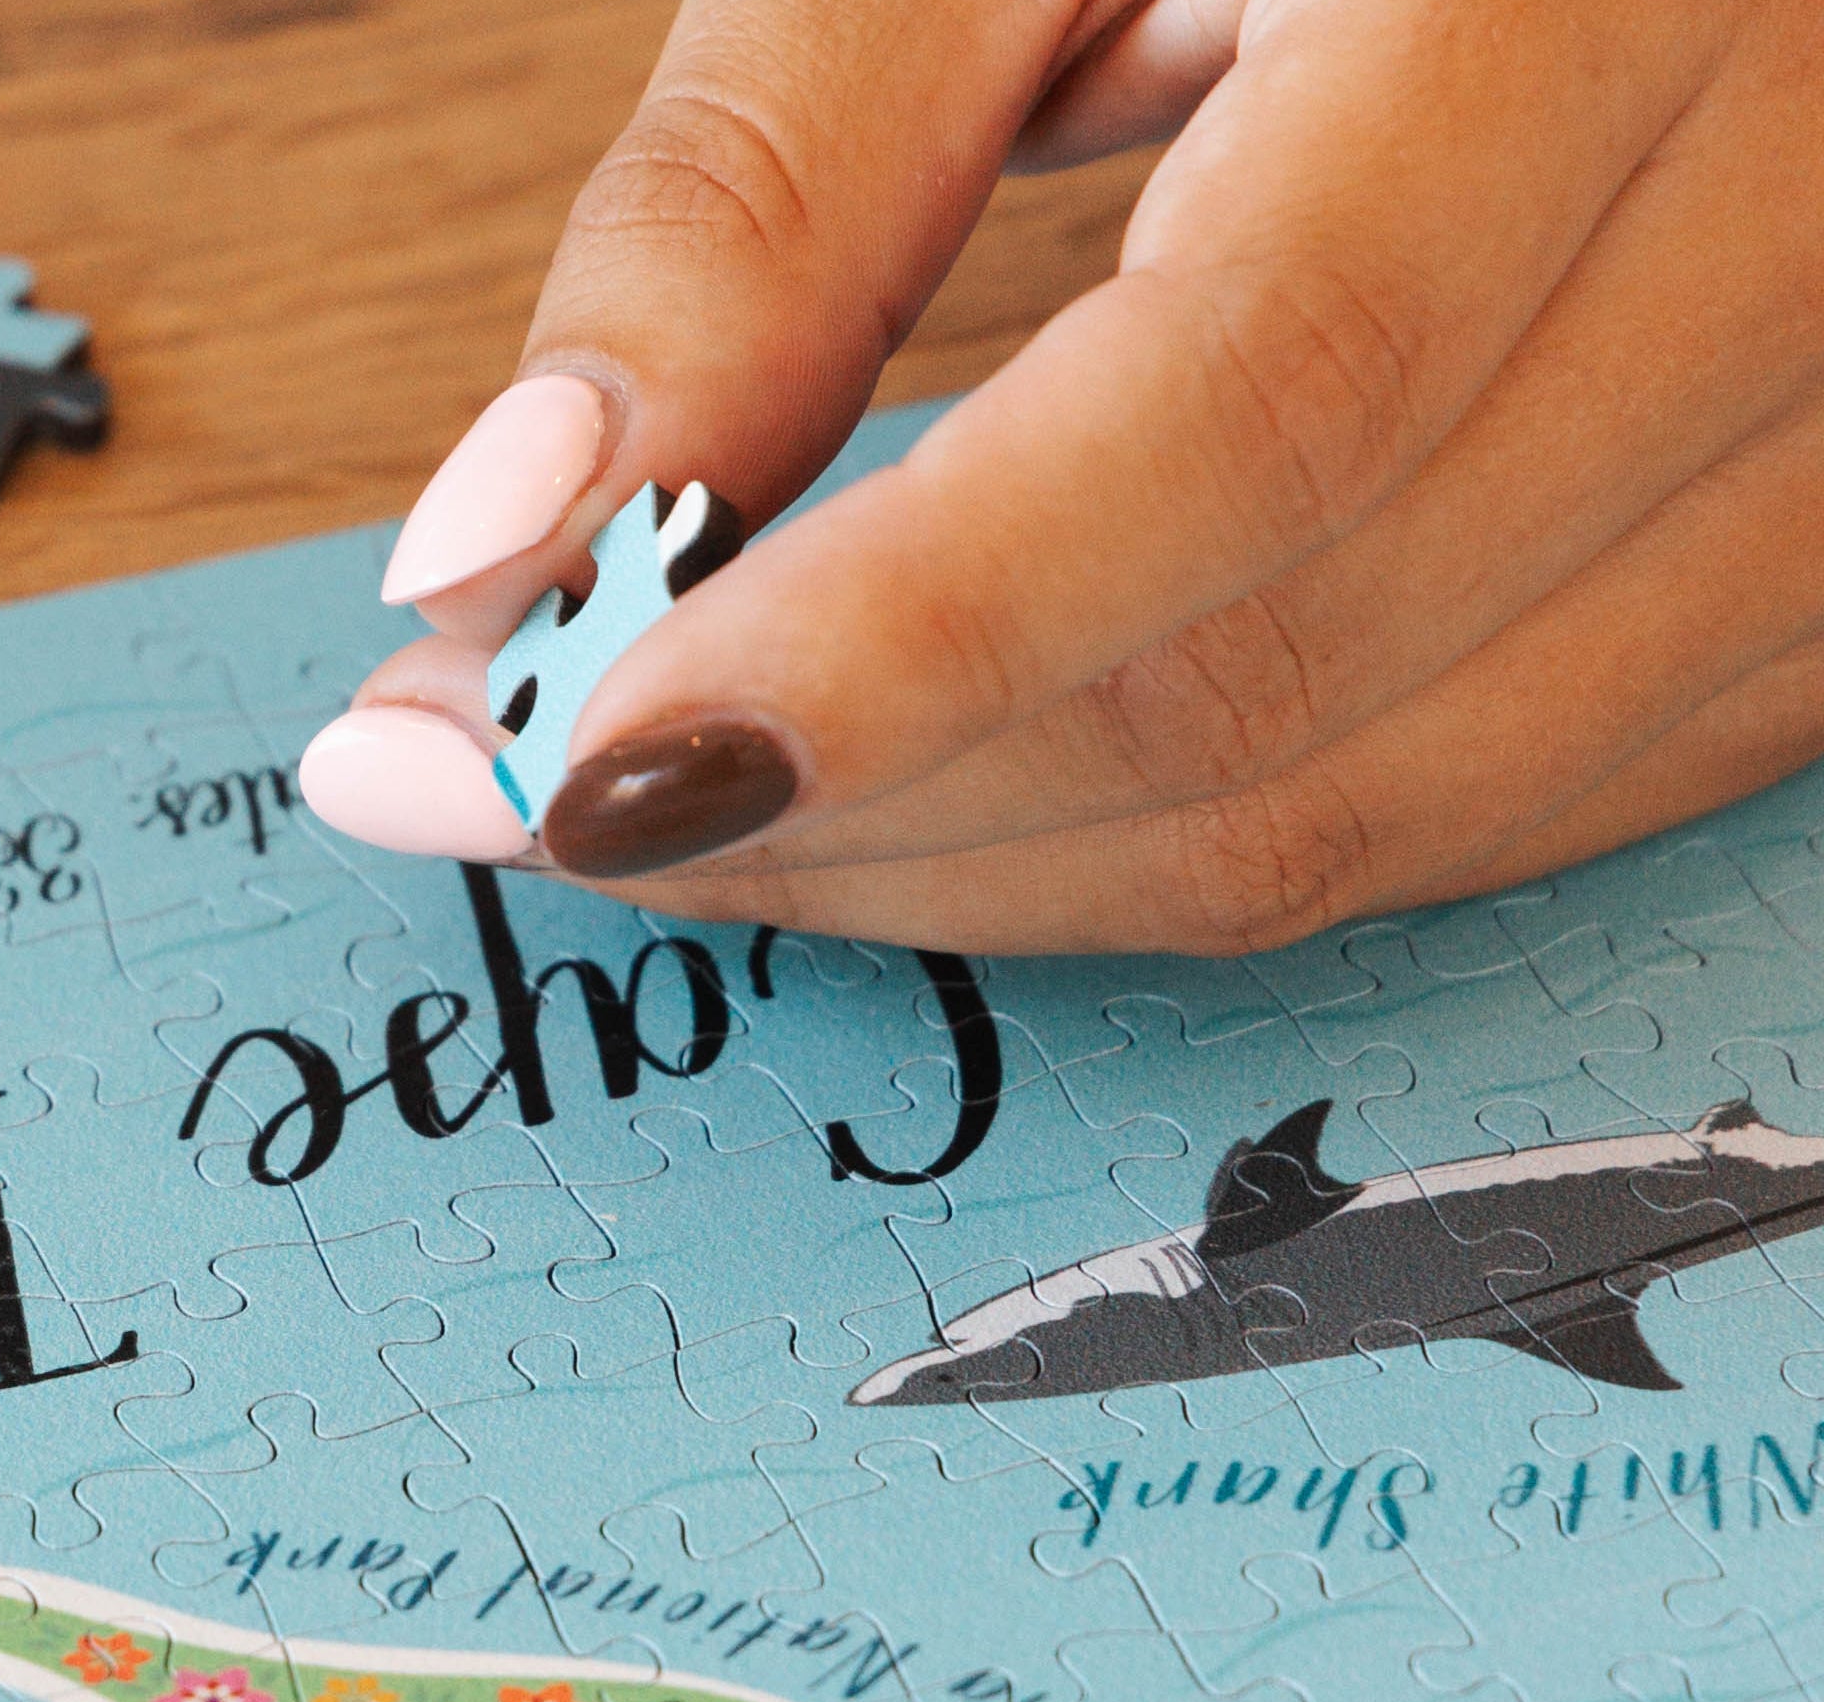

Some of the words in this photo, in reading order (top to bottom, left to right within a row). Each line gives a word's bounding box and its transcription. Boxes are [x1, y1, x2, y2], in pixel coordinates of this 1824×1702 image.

[179, 859, 1003, 1185] Cape
[1059, 1459, 1436, 1551] Shark
[1501, 1417, 1824, 1534] White
[224, 1529, 460, 1611] Park
[476, 1559, 921, 1699] National
